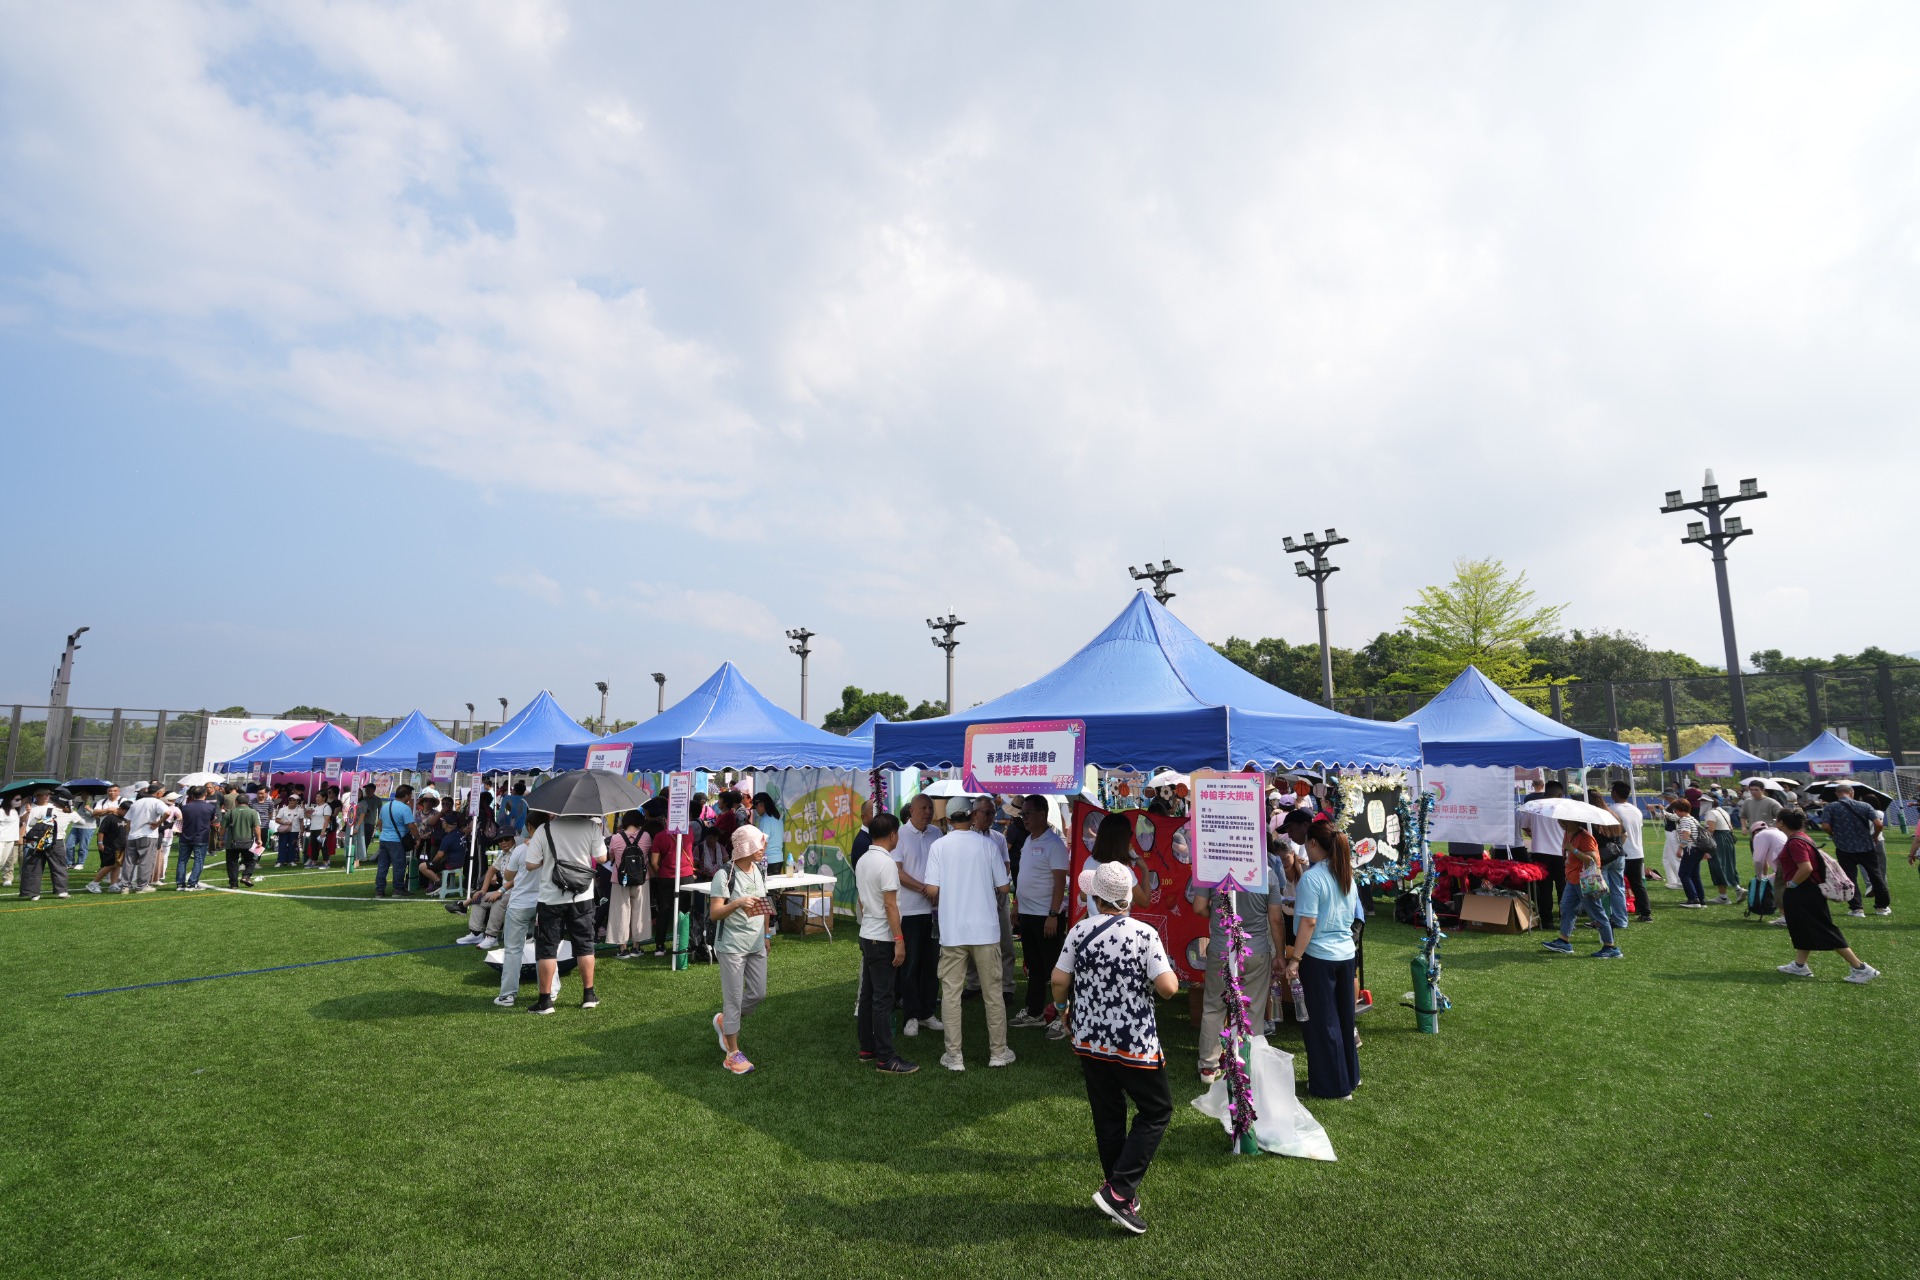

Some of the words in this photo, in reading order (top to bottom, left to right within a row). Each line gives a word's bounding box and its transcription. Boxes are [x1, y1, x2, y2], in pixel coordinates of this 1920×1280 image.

[1008, 738, 1034, 750] 龍崗區
[987, 751, 1057, 763] 香港坪地鄉親總會
[994, 764, 1048, 776] 神槍手大挑戰
[1200, 790, 1255, 802] 神槍手大挑戰
